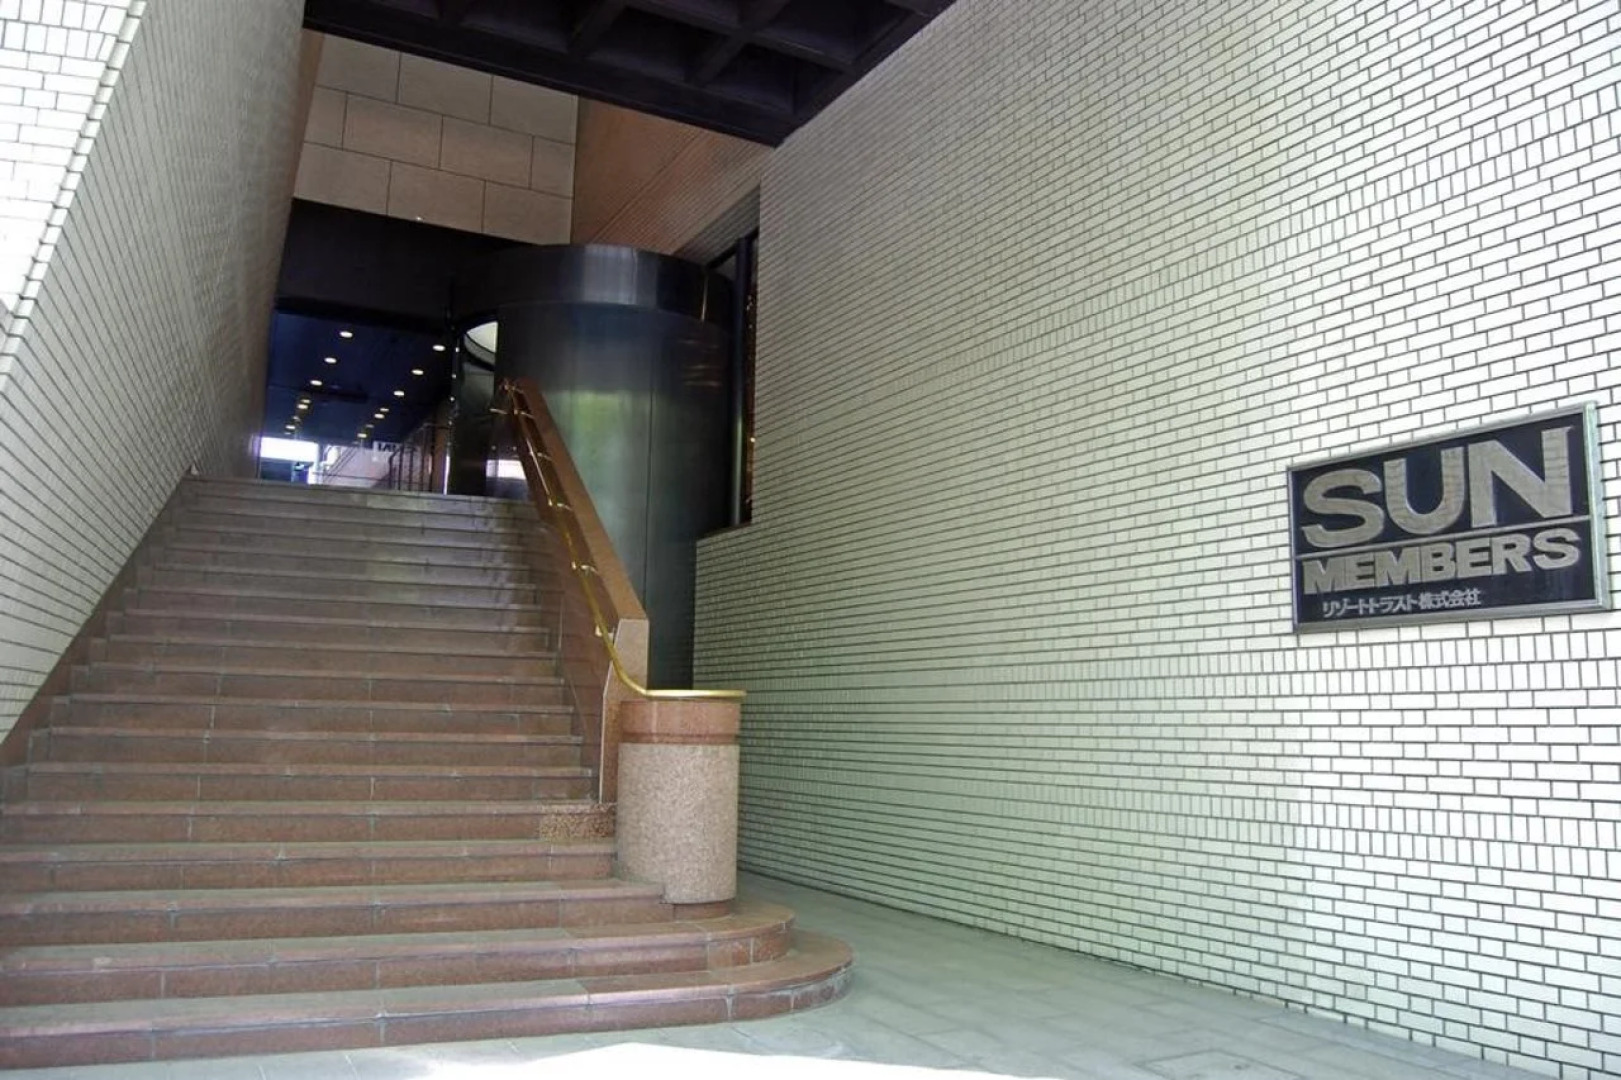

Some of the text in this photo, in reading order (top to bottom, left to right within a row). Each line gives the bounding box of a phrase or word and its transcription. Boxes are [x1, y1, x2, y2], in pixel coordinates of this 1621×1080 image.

[1301, 426, 1574, 548] SUN
[1302, 527, 1581, 595] MEMBERS
[1322, 588, 1481, 618] リゾートトラスト株式会社
